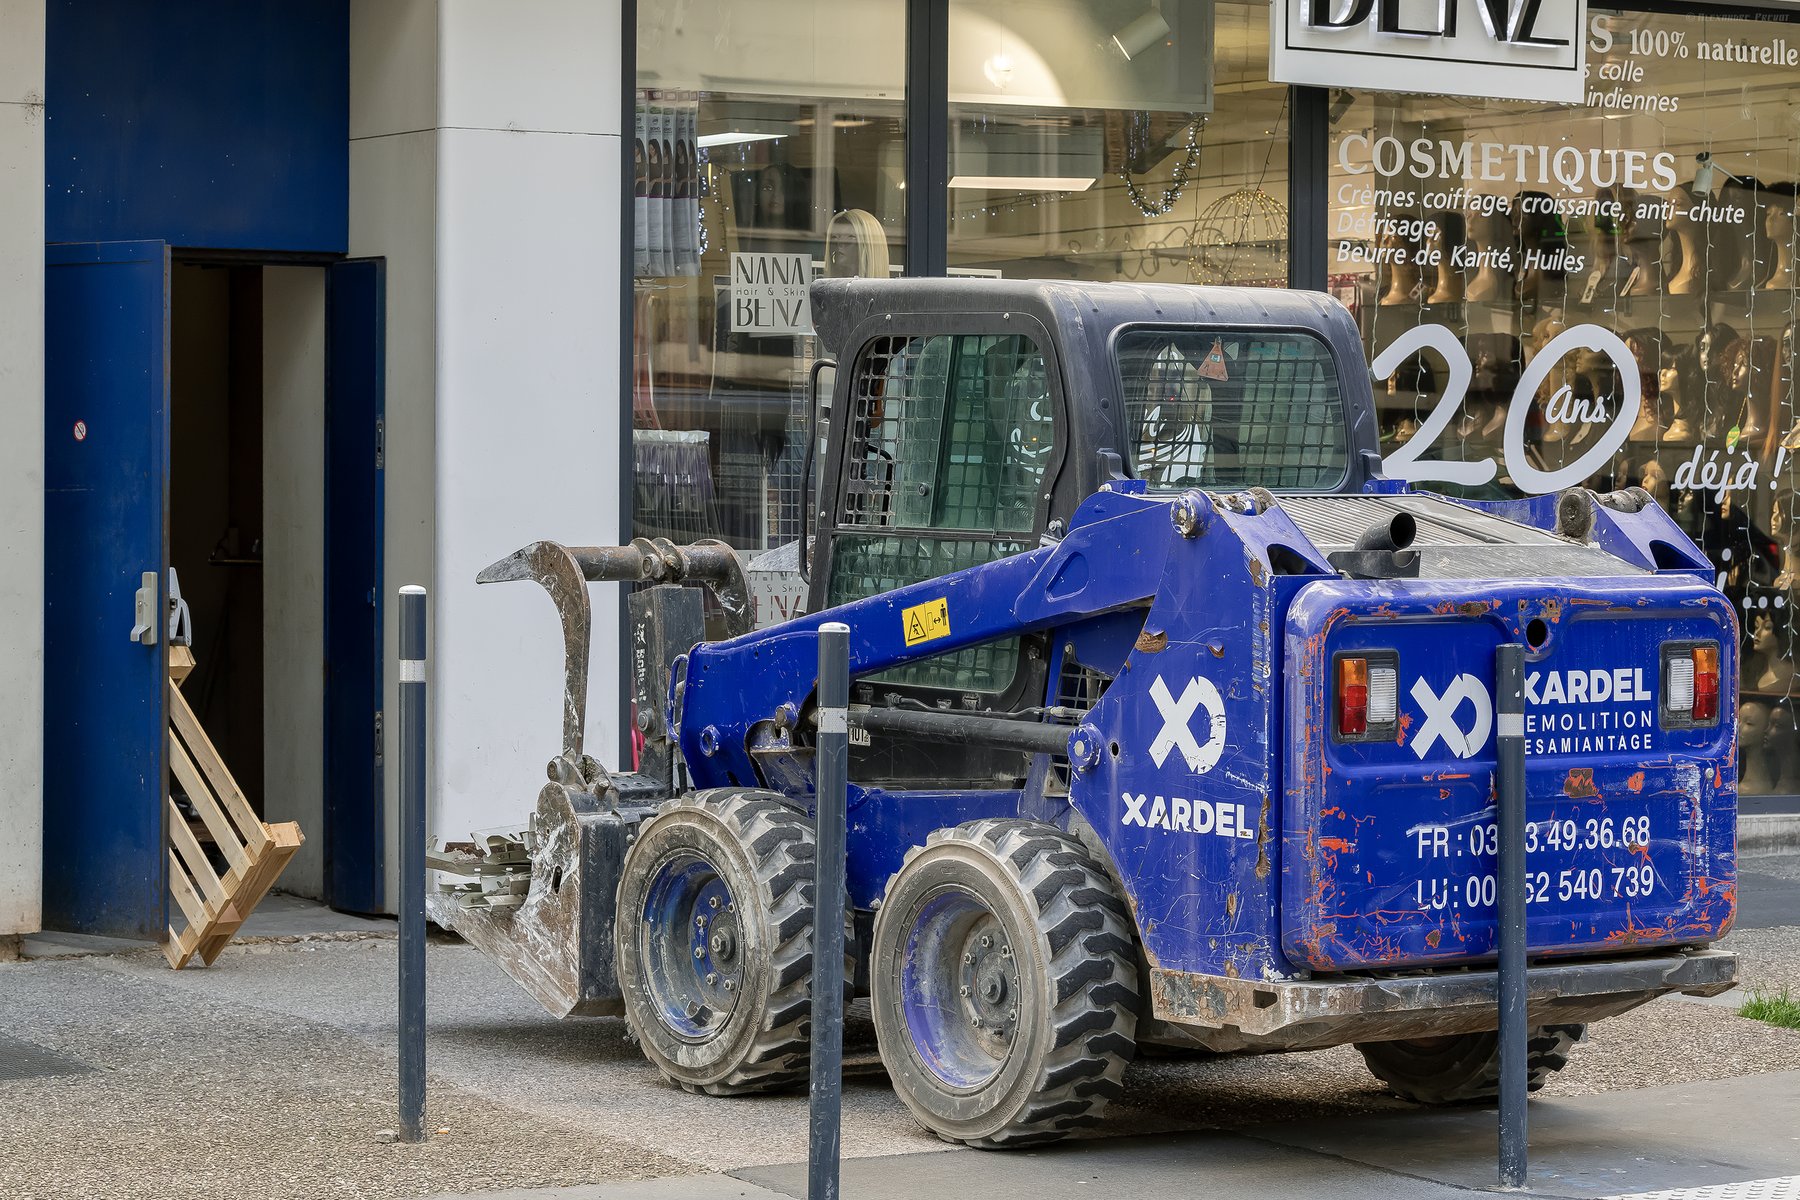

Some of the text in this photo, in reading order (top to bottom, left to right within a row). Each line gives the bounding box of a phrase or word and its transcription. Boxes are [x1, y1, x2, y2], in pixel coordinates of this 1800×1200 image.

[1629, 28, 1689, 59] 100%
[1599, 60, 1644, 82] colle
[1586, 86, 1679, 113] indiennes
[1338, 134, 1677, 193] COSMETIQUES
[1337, 183, 1415, 208] Crèmes
[1422, 187, 1512, 217] coiffage,
[1522, 194, 1626, 222] croissance,
[1337, 212, 1441, 242] Défrisage,
[736, 256, 805, 285] NANA
[1337, 240, 1585, 272] Beurre de Karité, Huiles
[767, 287, 774, 296] &
[783, 287, 806, 296] Skin
[736, 298, 803, 327] BENZ
[1371, 323, 1641, 495] 20
[1670, 444, 1760, 504] déjà
[1526, 711, 1652, 733] EMOLITION
[1525, 734, 1652, 755] ESAMIANTAGE
[1121, 792, 1254, 840] XARDEL
[1558, 868, 1603, 902] 540
[1611, 865, 1654, 898] 739
